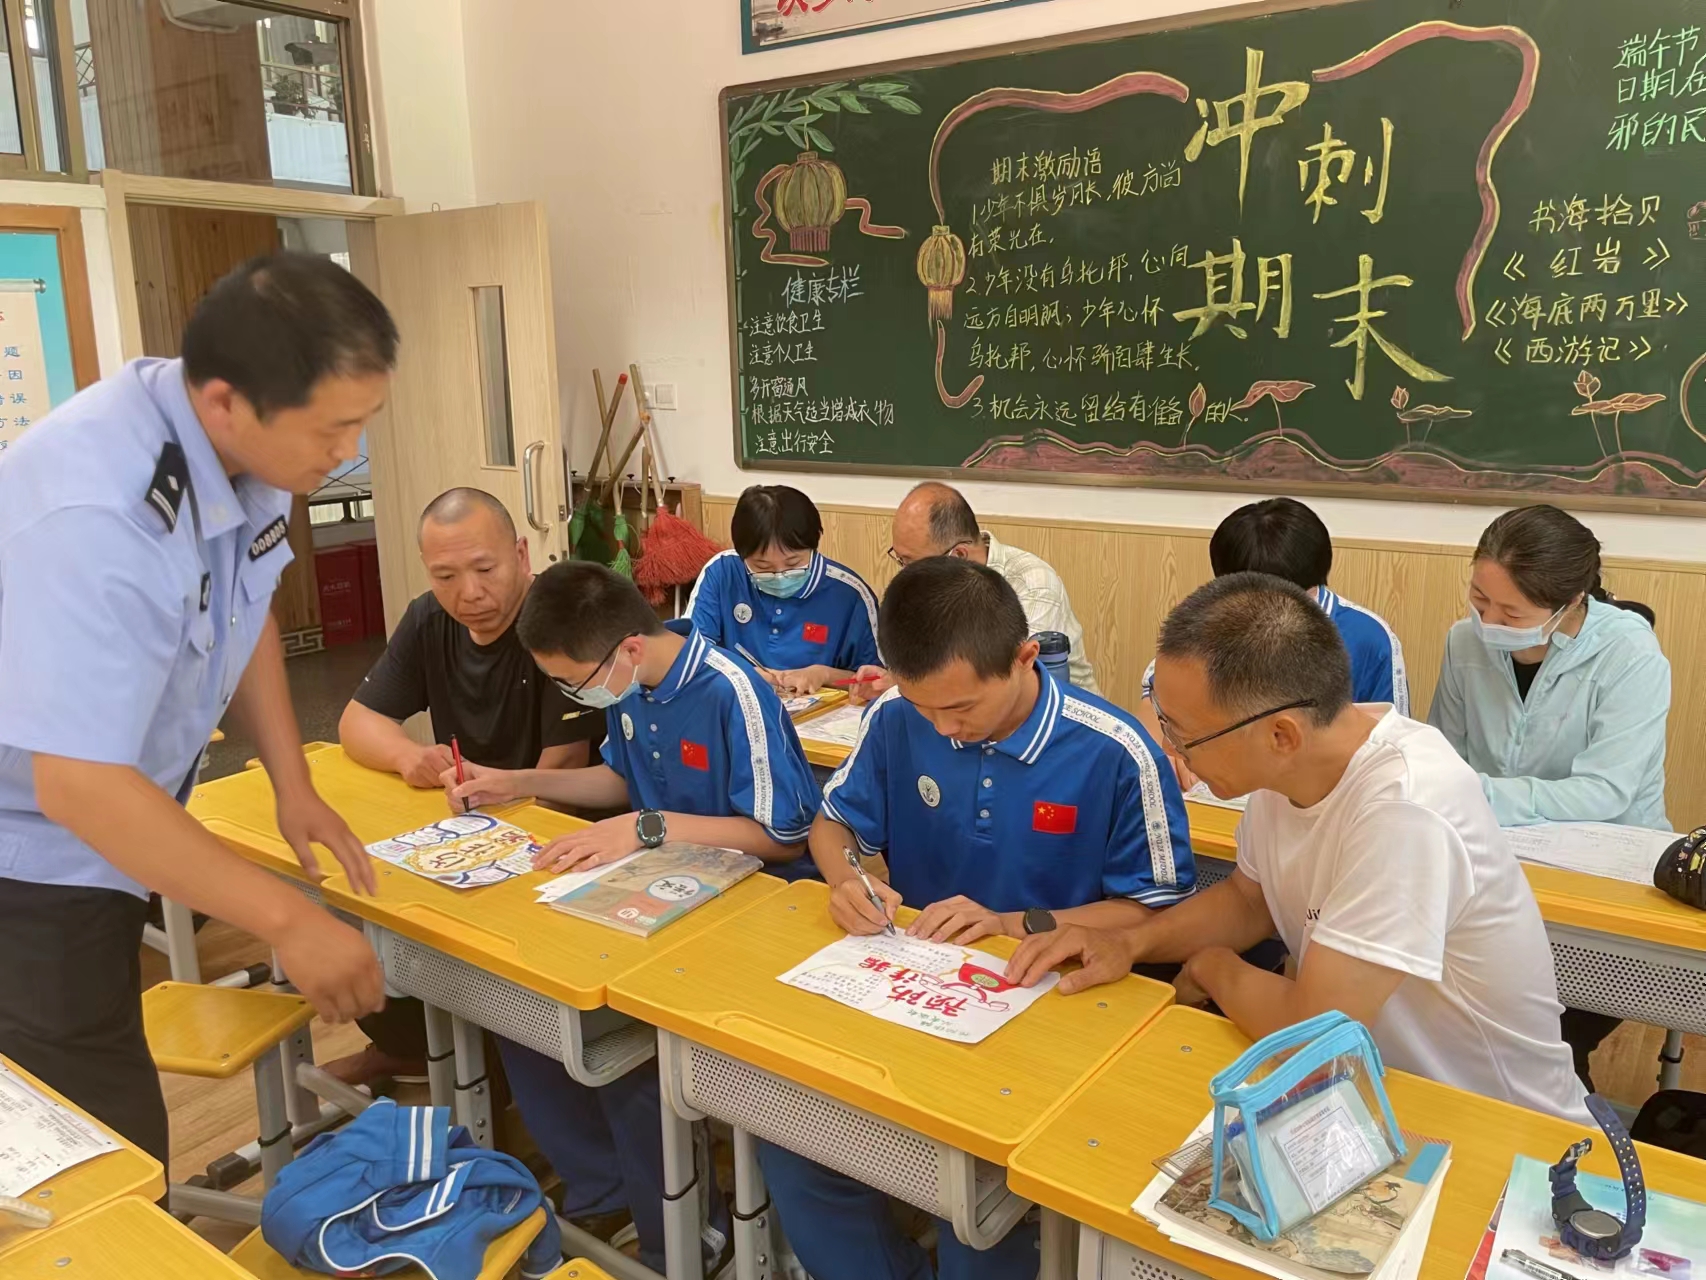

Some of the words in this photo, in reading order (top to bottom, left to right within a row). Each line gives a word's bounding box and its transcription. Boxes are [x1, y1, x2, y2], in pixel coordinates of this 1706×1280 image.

[1613, 25, 1702, 72] 端午节
[1184, 47, 1394, 226] 冲刺
[990, 147, 1102, 186] 期末激励语
[1529, 194, 1662, 236] 书海拾贝
[781, 264, 865, 308] 健康专栏
[749, 309, 826, 337] 注意饮食卫生
[1172, 237, 1455, 401] 期末
[1484, 290, 1689, 332] 《海底两万里》
[749, 340, 818, 366] 注意个人卫生
[1493, 336, 1653, 366] 《西游记》
[748, 375, 809, 401] 多开窗通风
[751, 396, 895, 427] 根据天气适当增减衣物
[755, 428, 835, 455] 注意出行安全
